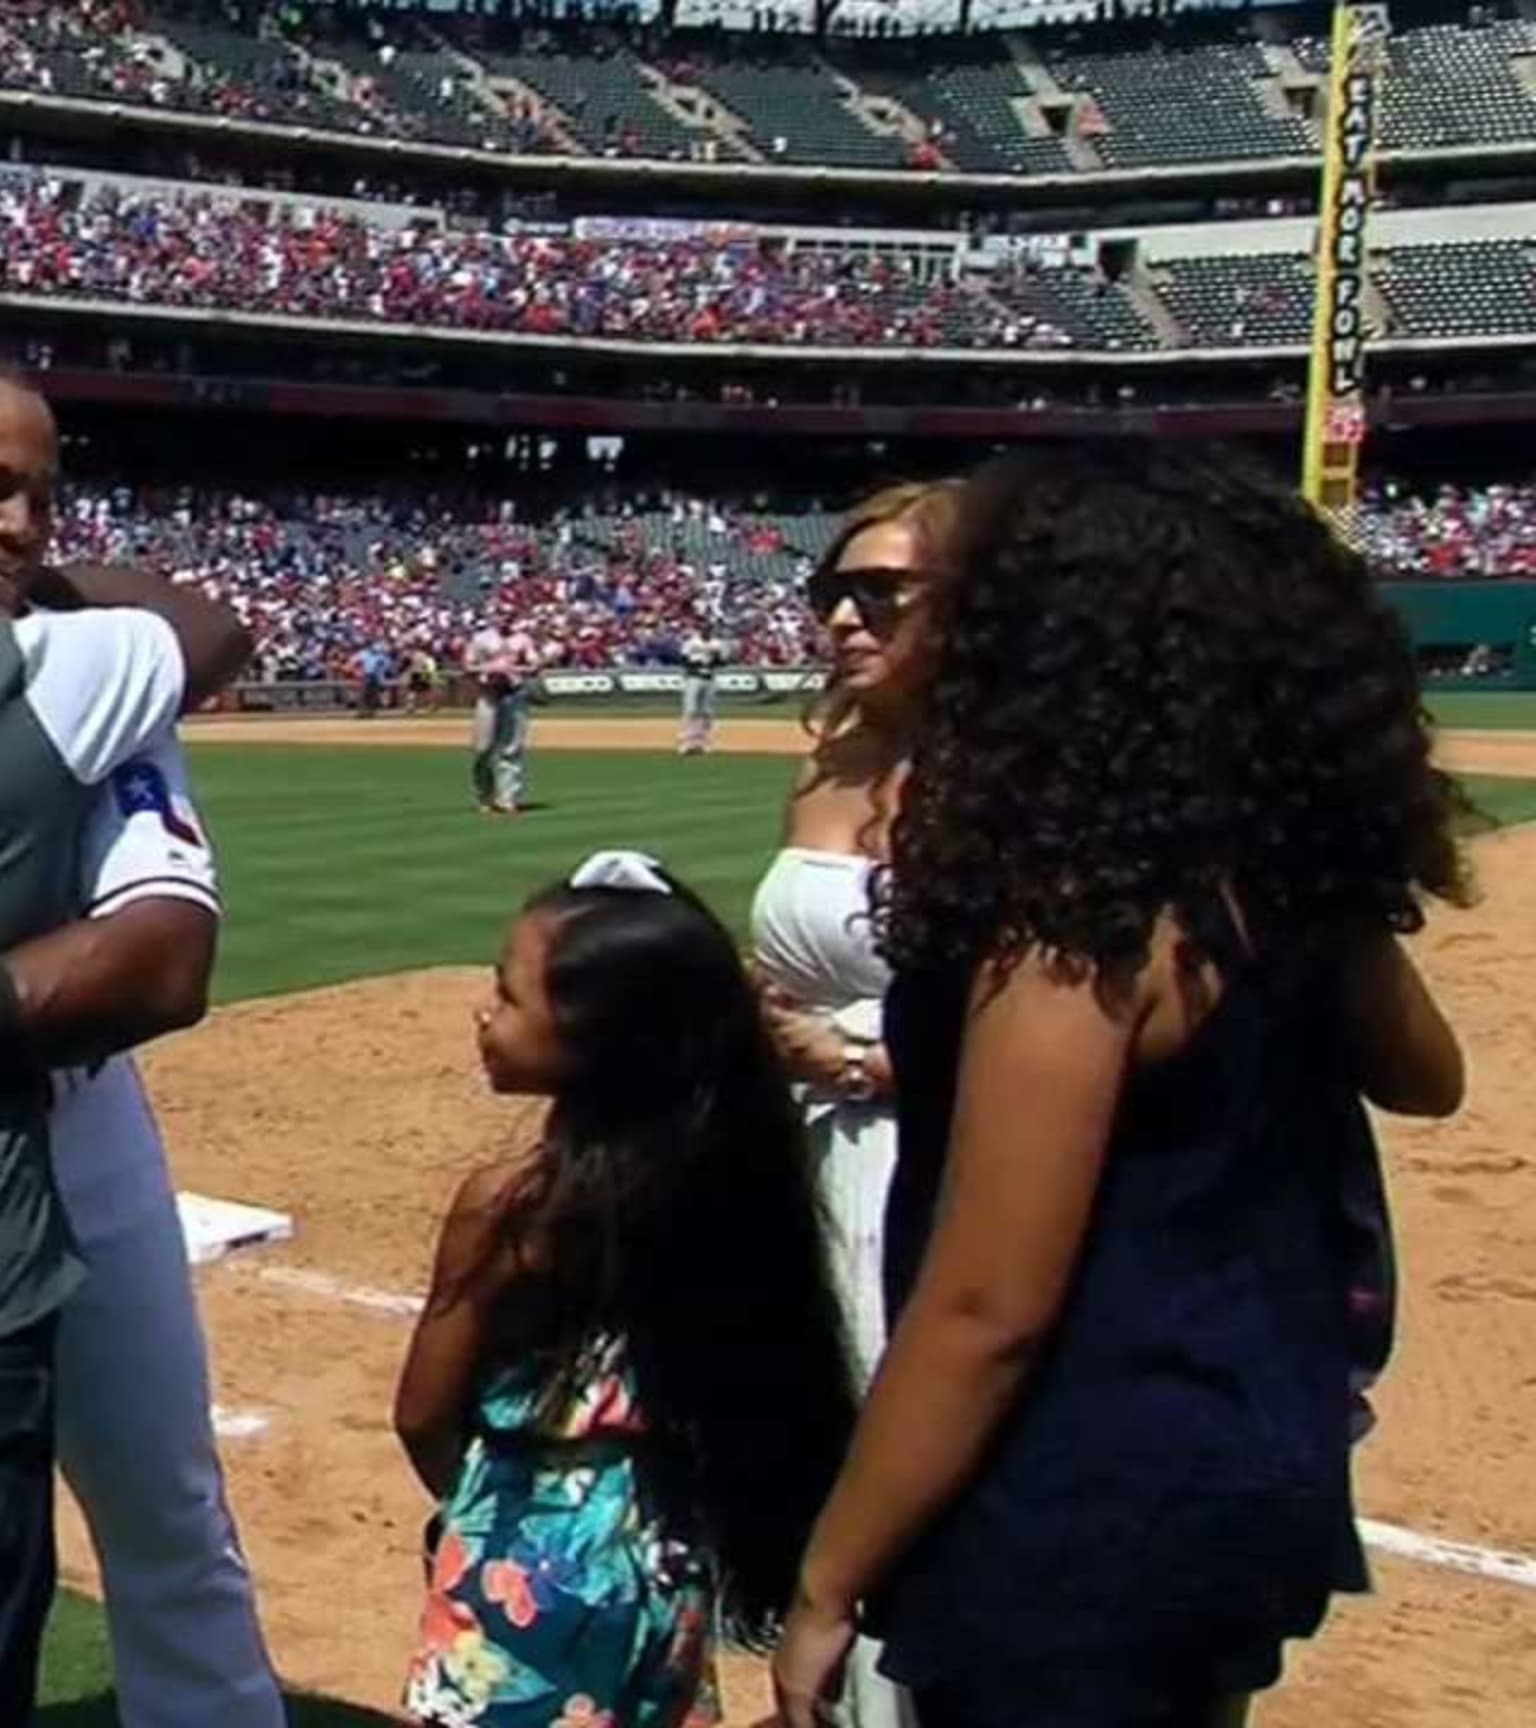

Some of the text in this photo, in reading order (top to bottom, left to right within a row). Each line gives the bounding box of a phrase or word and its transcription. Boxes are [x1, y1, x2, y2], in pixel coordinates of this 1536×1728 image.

[1344, 79, 1367, 163] EAT
[1338, 179, 1365, 264] MOR
[1332, 279, 1357, 390] FOWL
